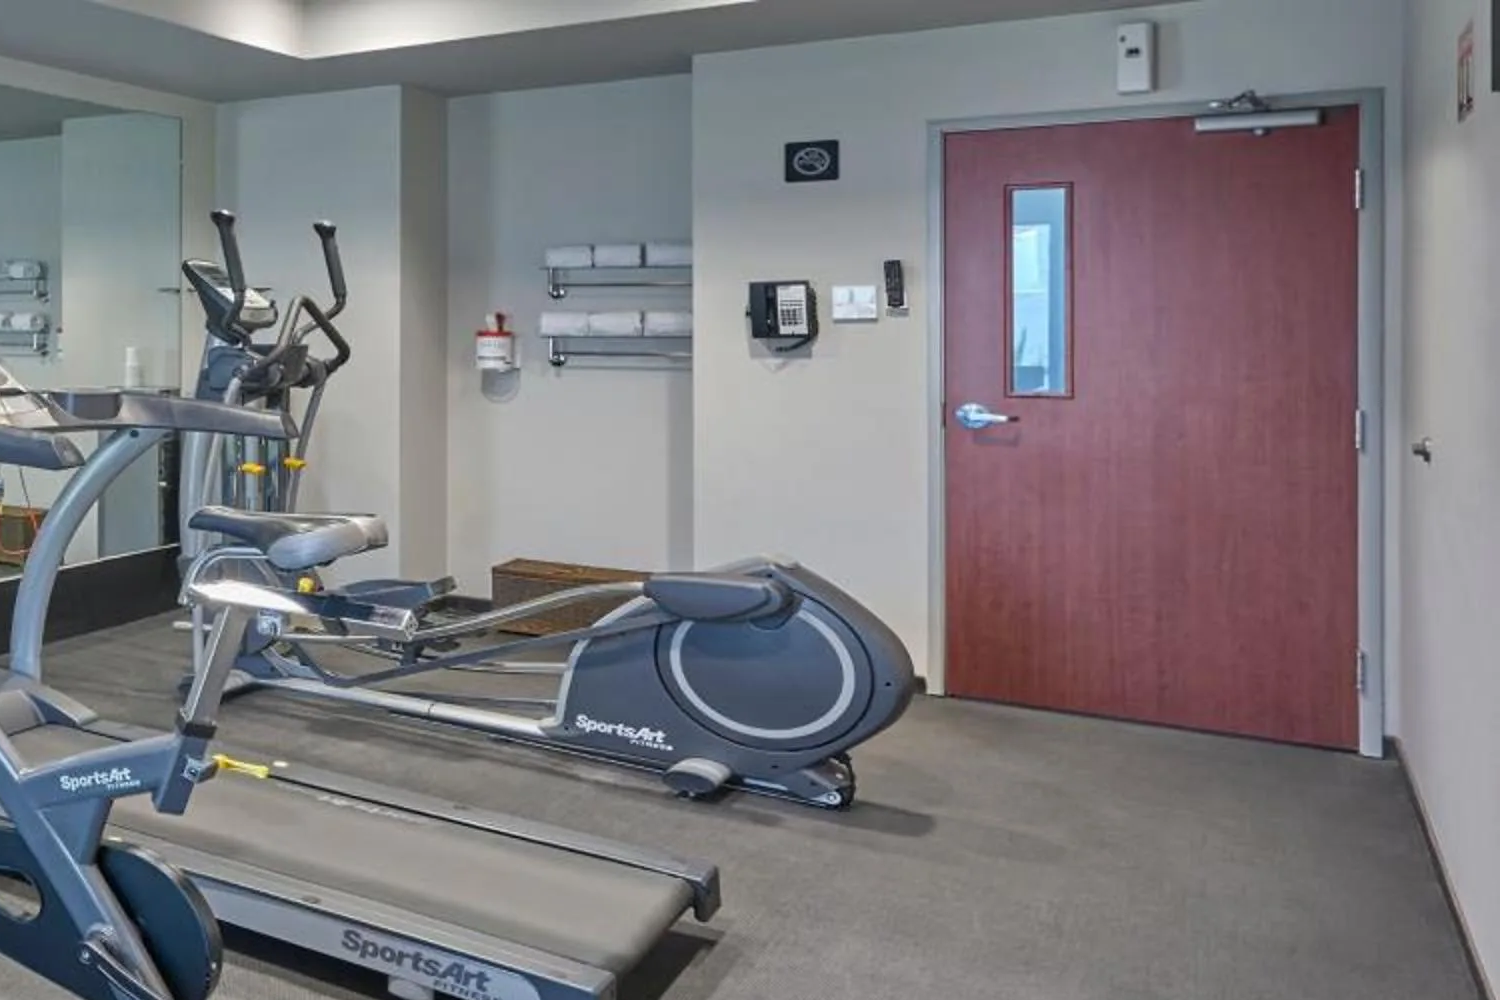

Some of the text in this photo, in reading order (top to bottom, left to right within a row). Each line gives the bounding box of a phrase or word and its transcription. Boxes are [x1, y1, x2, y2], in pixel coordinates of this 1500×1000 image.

[576, 714, 666, 742] SportsArt
[60, 768, 131, 791] SportsArt
[341, 929, 490, 991] SportsArt
